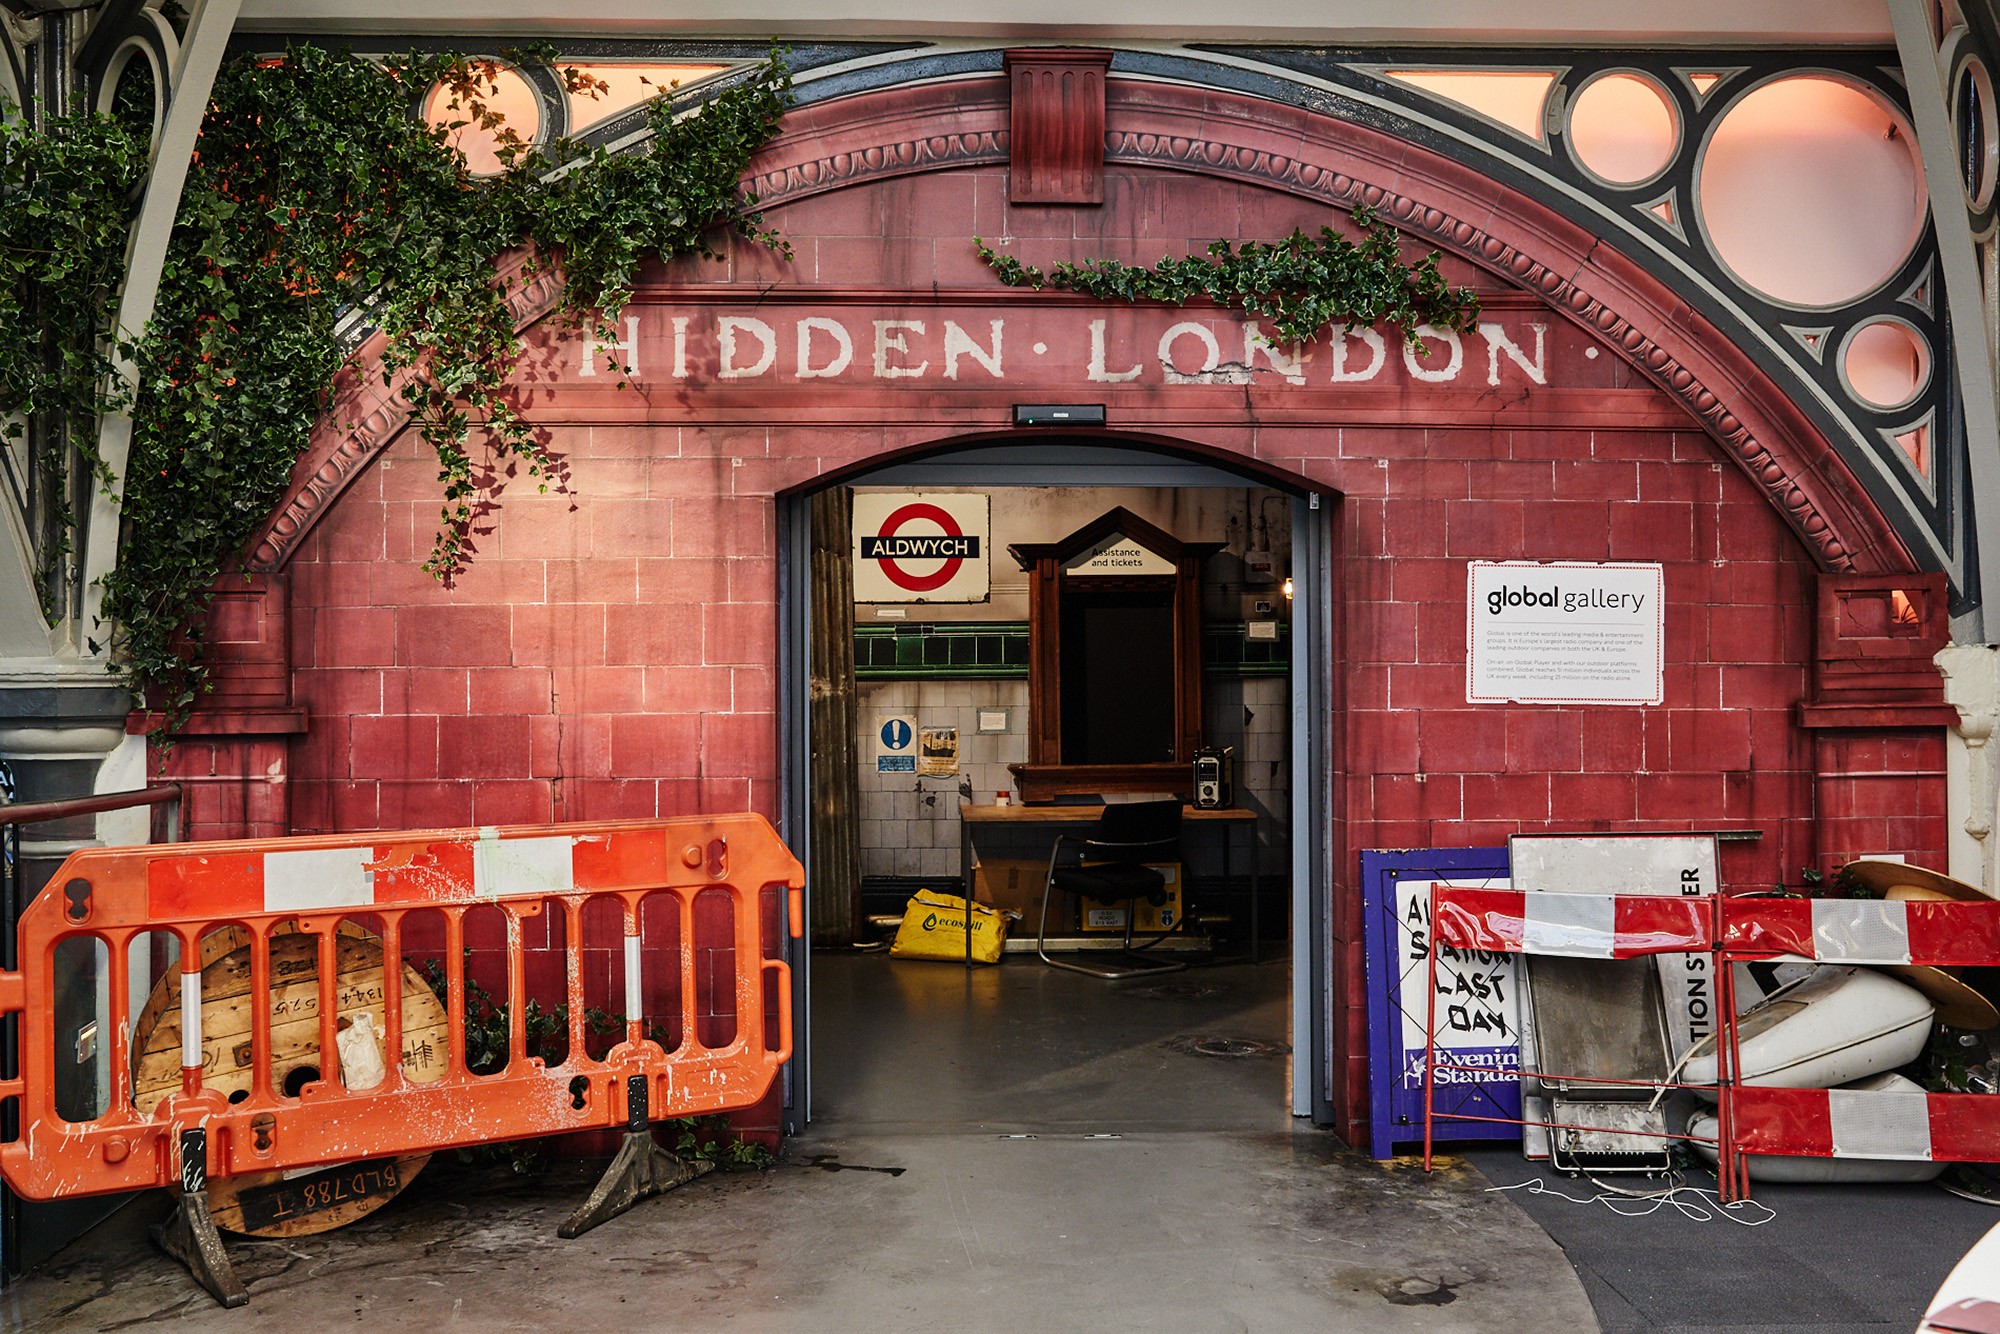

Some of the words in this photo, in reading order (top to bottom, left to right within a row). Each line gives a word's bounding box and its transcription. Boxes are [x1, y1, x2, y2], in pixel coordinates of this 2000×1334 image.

[578, 316, 1006, 380] HIDDEN
[1087, 319, 1549, 386] LONDON
[871, 539, 969, 556] ALDWYCH
[1091, 548, 1141, 557] Assistance
[1091, 559, 1108, 567] and
[1111, 559, 1143, 567] tickets
[1487, 585, 1559, 615] global
[1563, 588, 1645, 613] gallery
[1561, 631, 1581, 639] leading
[1486, 645, 1506, 653] leading
[1533, 659, 1550, 667] Player
[1609, 660, 1637, 668] platforms
[1528, 674, 1554, 682] including
[341, 986, 383, 1005] 1344
[1435, 971, 1506, 1003] LAST
[1447, 1004, 1507, 1039] DAY
[1433, 1048, 1520, 1067] Evenin
